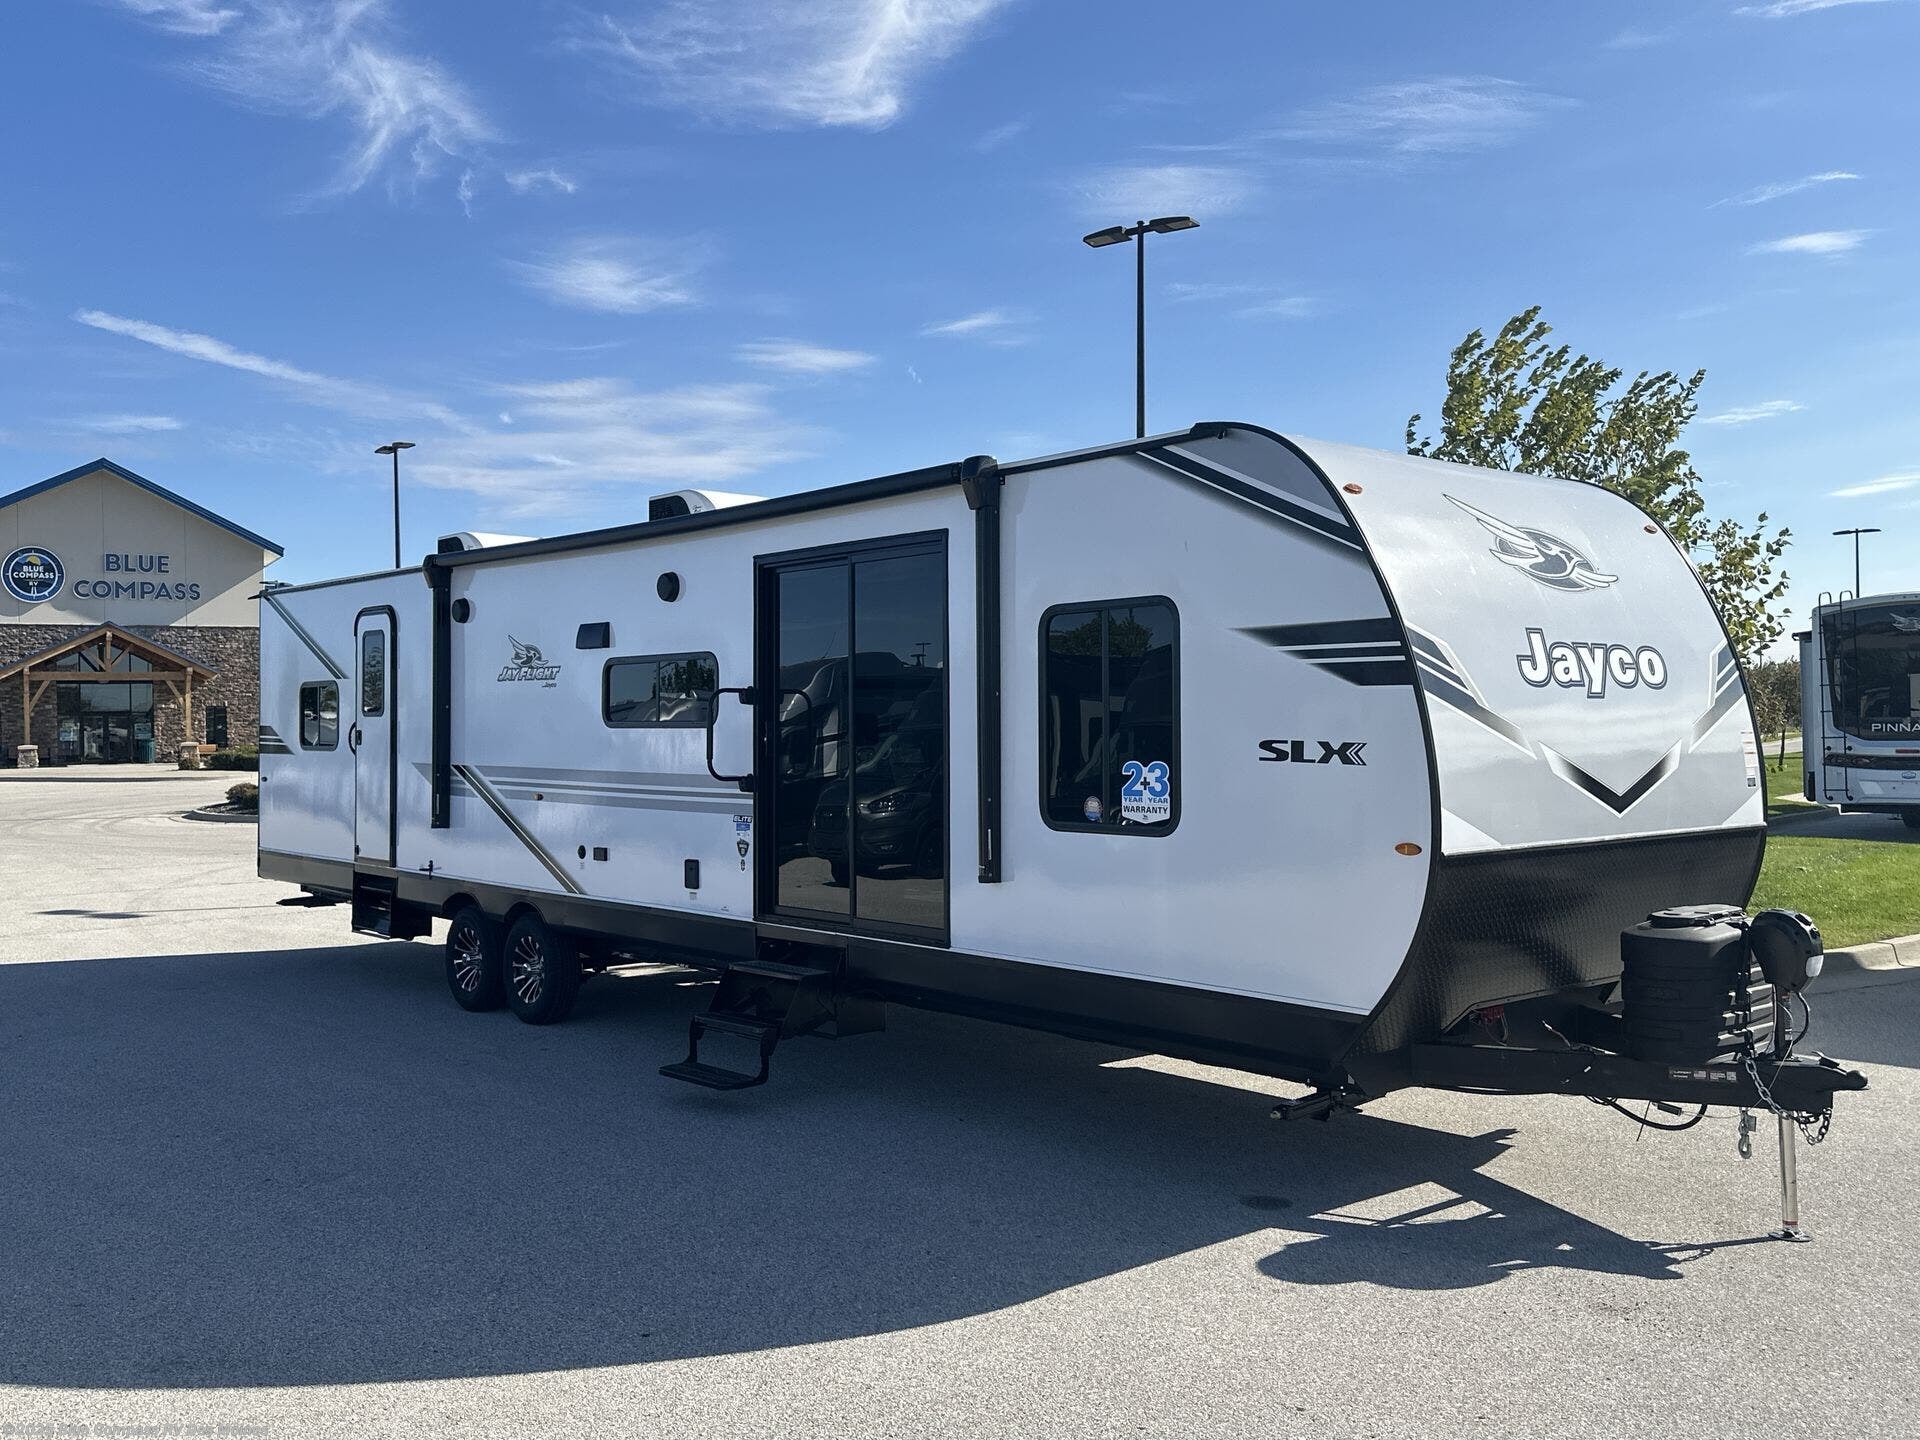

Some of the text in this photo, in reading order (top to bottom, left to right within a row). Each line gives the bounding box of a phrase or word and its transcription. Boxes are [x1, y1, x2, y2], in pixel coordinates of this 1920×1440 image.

[105, 553, 170, 573] BLUE
[74, 576, 201, 600] COMPASS
[497, 665, 561, 682] JAY FLIGHT
[1516, 627, 1668, 699] Jayco
[1258, 739, 1367, 766] SLX
[1123, 805, 1168, 815] WARRANTY
